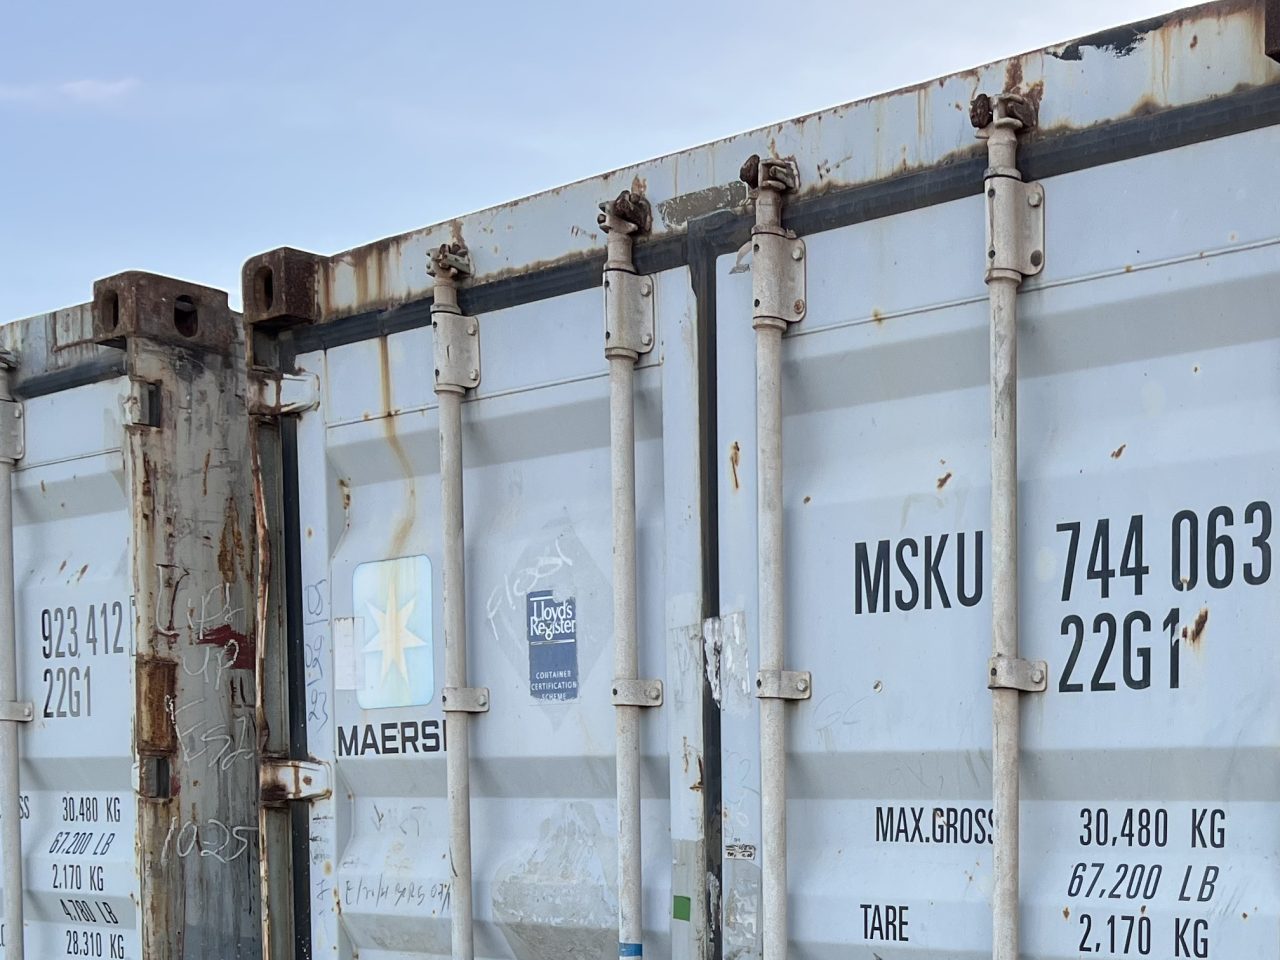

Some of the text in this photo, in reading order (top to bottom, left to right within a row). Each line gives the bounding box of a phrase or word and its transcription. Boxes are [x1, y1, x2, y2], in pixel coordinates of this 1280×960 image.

[855, 530, 984, 615] MSKU
[1056, 514, 1149, 602] 744
[1171, 501, 1272, 592] 063
[530, 617, 577, 640] Register
[1058, 608, 1180, 693] 22G1
[531, 681, 577, 691] CERTIFICATION
[535, 670, 572, 680] CONTAINER
[43, 666, 91, 718] 22G1
[338, 720, 447, 756] MAERS
[106, 797, 121, 822] KG
[1191, 808, 1226, 848] KG
[93, 833, 116, 855] LB
[89, 866, 104, 891] KG
[1178, 865, 1219, 902] LB
[95, 901, 119, 924] LB
[860, 904, 909, 942] TARE
[1174, 917, 1209, 959] KG
[110, 934, 125, 960] KG
